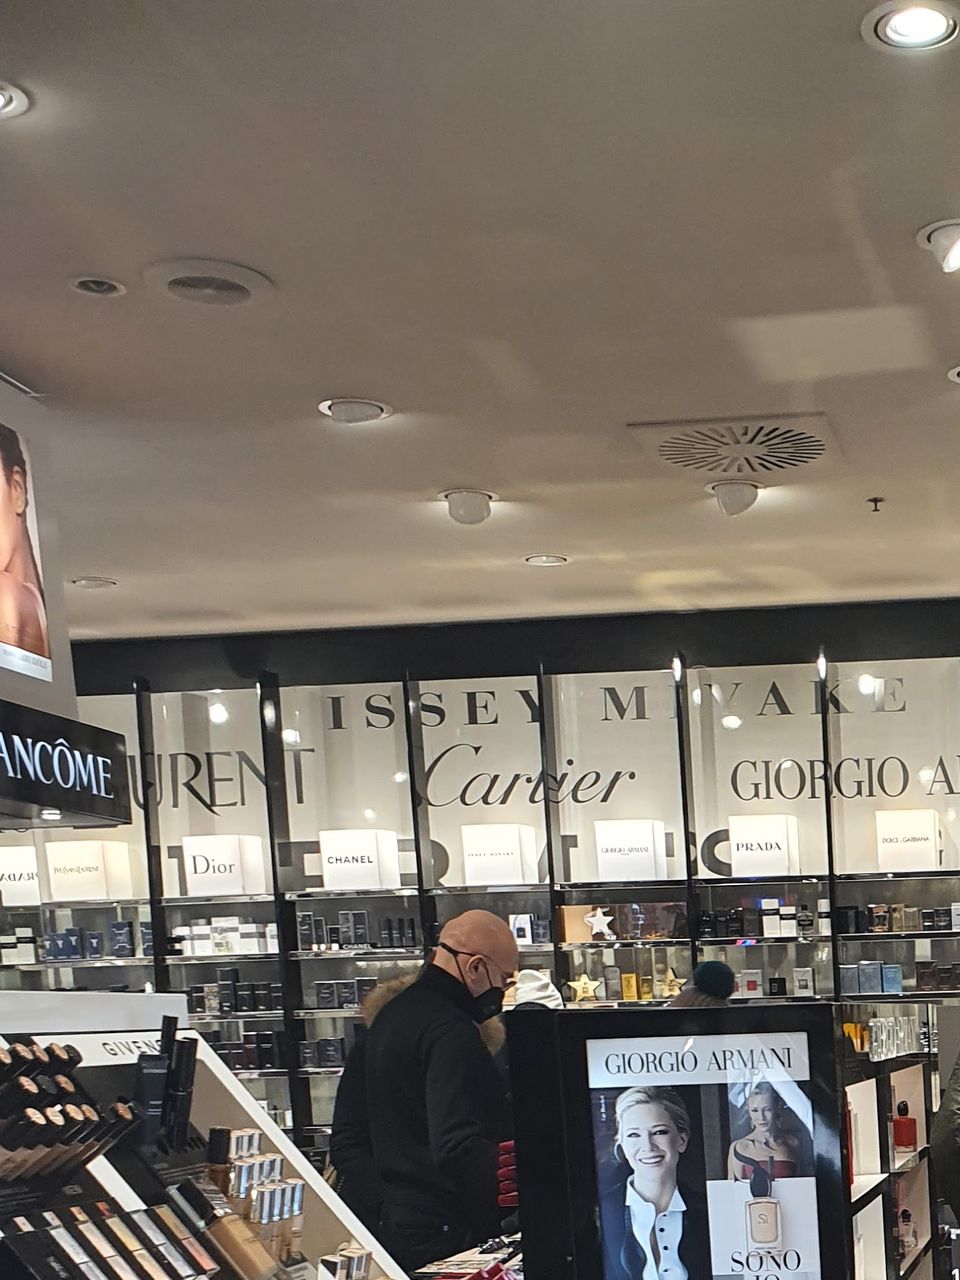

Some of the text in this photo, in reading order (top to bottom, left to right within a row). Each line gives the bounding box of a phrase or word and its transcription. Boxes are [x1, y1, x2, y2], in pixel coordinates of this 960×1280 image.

[328, 688, 541, 730] ISSEY
[0, 732, 115, 799] ANCÔME
[128, 748, 315, 816] URENT
[417, 743, 636, 808] Cartier
[730, 756, 910, 800] GIORGIO
[192, 854, 236, 875] Dior
[327, 855, 374, 865] CHANEL
[736, 842, 782, 852] PRADA
[604, 1046, 793, 1076] GIORGIO ARMANI
[730, 1249, 802, 1273] SONO
